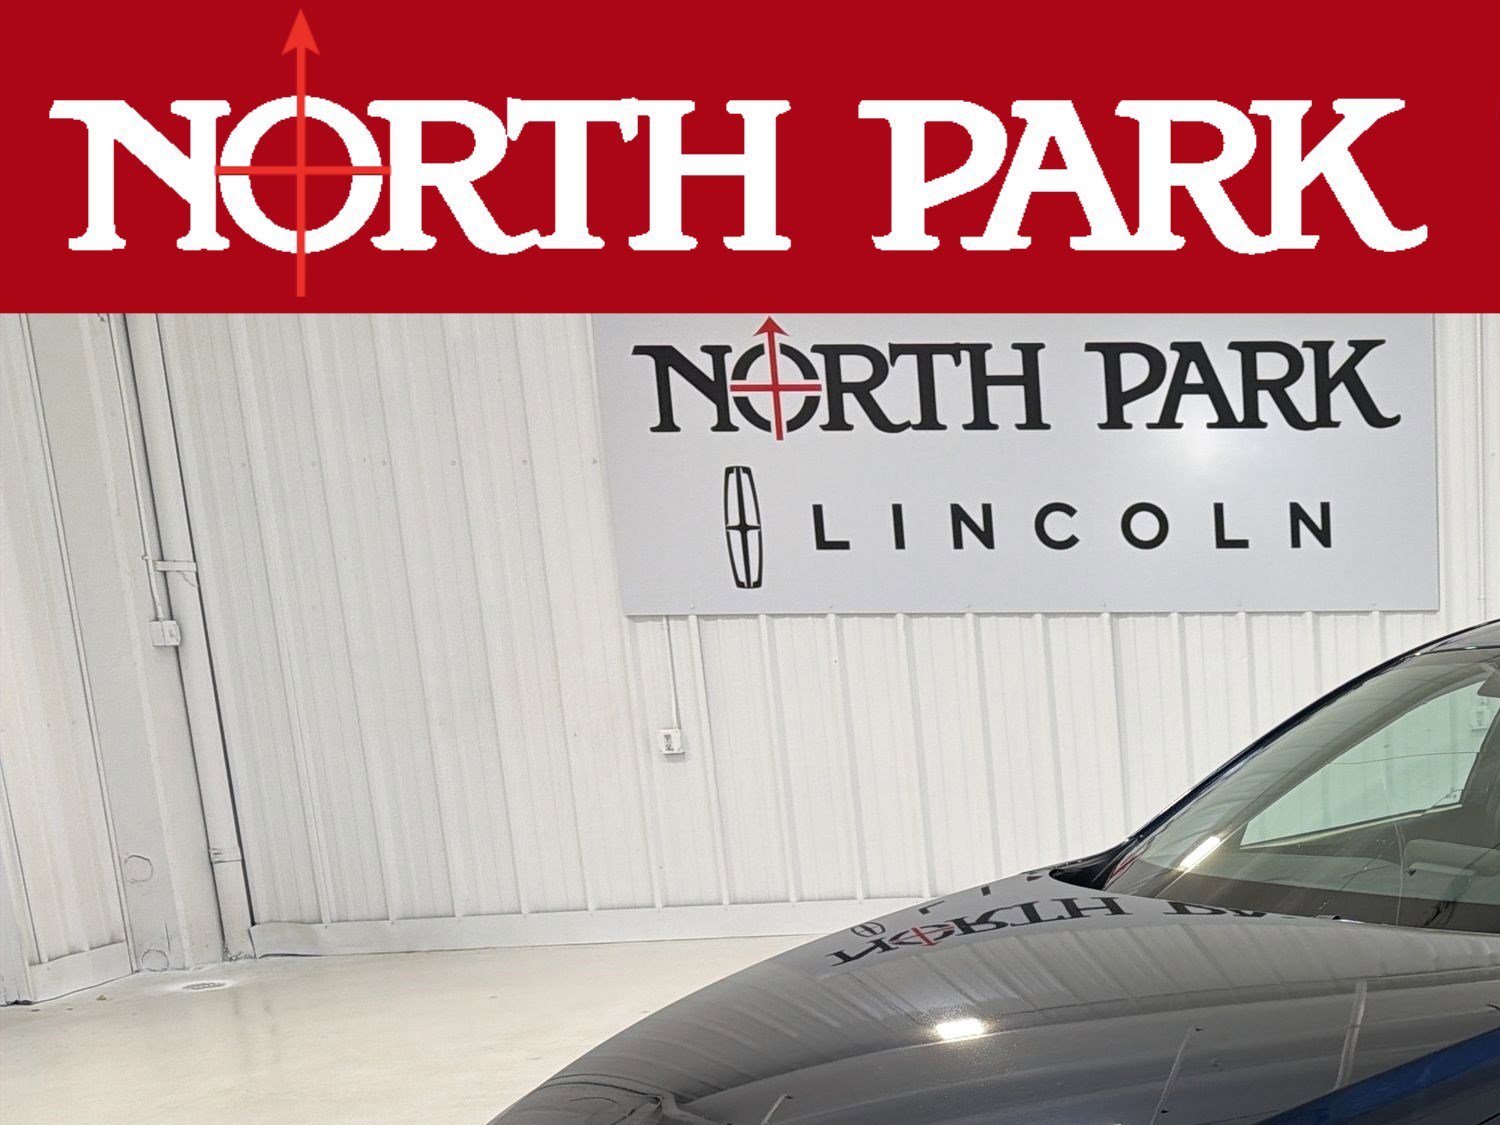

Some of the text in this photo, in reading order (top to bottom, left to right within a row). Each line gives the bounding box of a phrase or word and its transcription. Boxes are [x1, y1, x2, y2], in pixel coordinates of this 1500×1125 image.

[632, 340, 1401, 434] NORTH PARK
[813, 501, 1332, 551] LINCOLN
